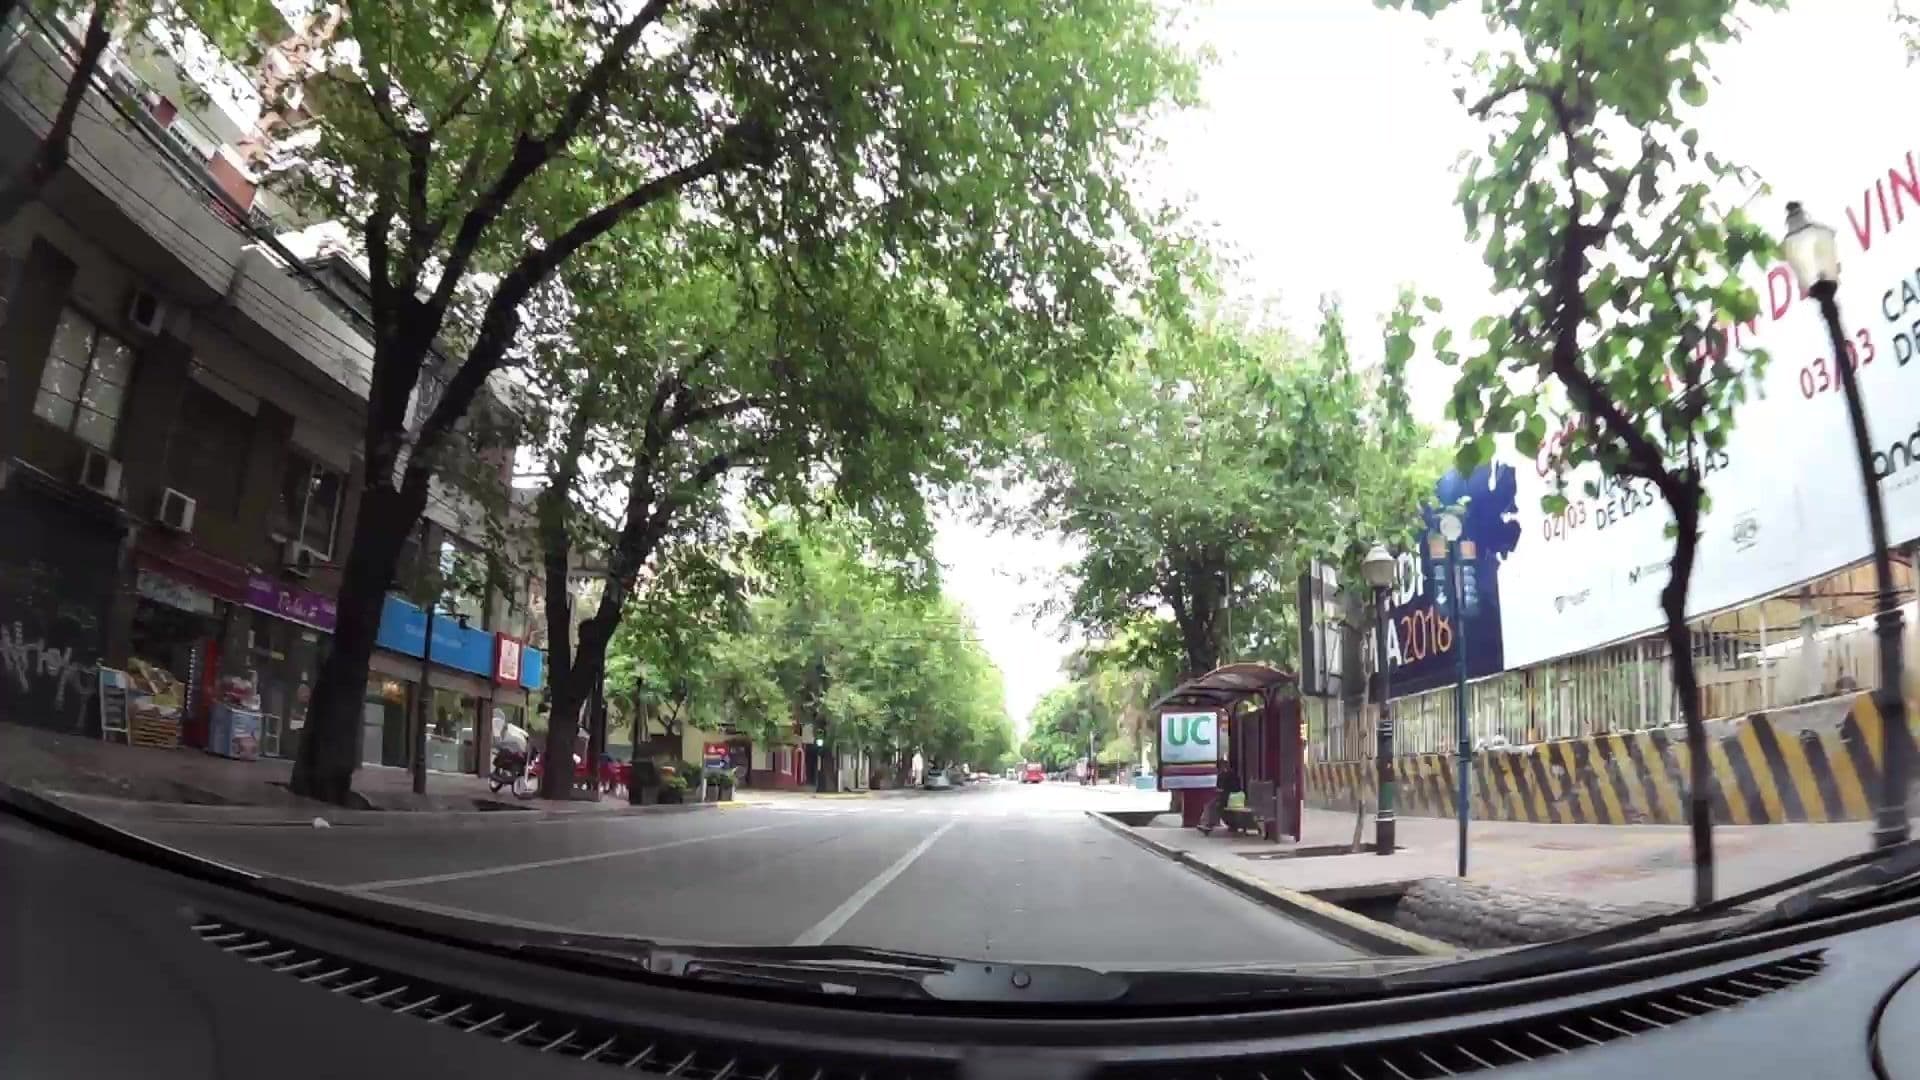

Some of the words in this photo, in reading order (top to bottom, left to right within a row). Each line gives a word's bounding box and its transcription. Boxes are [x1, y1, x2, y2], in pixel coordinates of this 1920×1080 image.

[1543, 500, 1588, 542] 02/03
[1596, 502, 1618, 531] DE
[1621, 480, 1655, 518] LAS
[1167, 715, 1212, 747] UC
